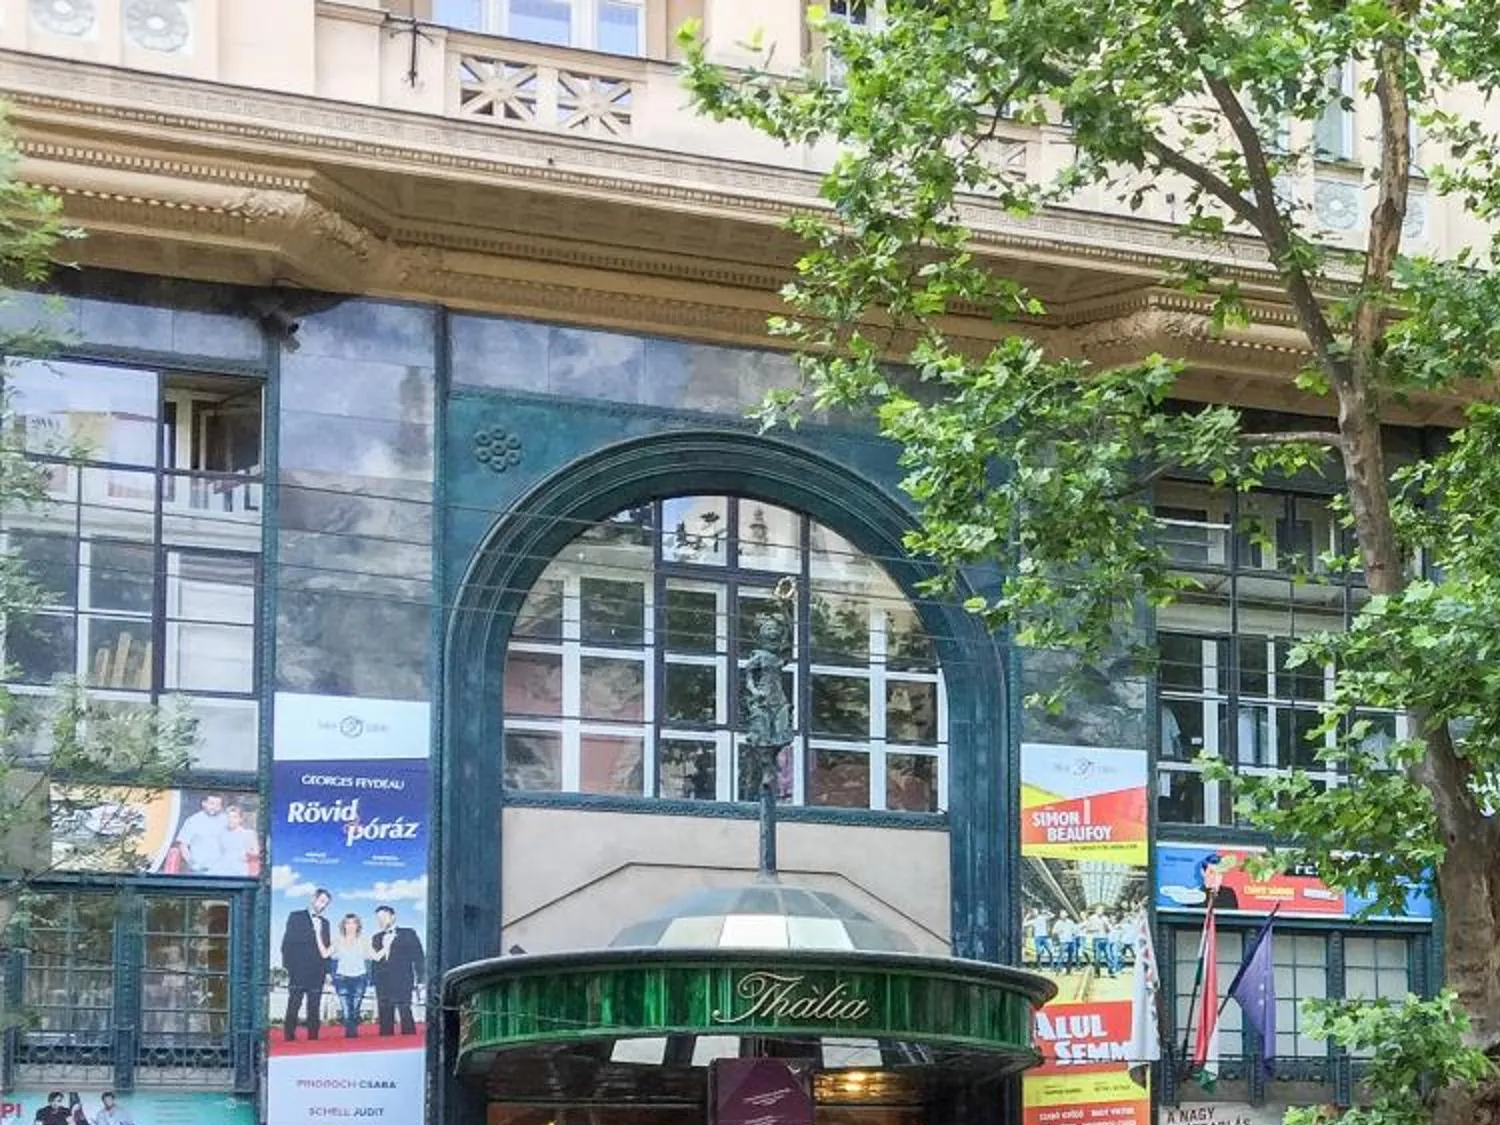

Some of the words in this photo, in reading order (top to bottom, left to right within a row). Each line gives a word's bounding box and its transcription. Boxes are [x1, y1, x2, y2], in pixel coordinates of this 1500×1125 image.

[301, 774, 353, 787] GEORGES
[287, 798, 361, 823] Rövid
[1031, 811, 1080, 827] SIMON
[345, 816, 420, 847] póráz
[1047, 825, 1113, 841] BEAUFOY
[1033, 1010, 1108, 1040] ALUL
[1054, 1040, 1132, 1066] SEMM
[309, 1107, 350, 1117] SCHELL
[353, 1107, 385, 1117] JUDIT
[1167, 1111, 1175, 1123] A
[1180, 1107, 1215, 1122] NAGY
